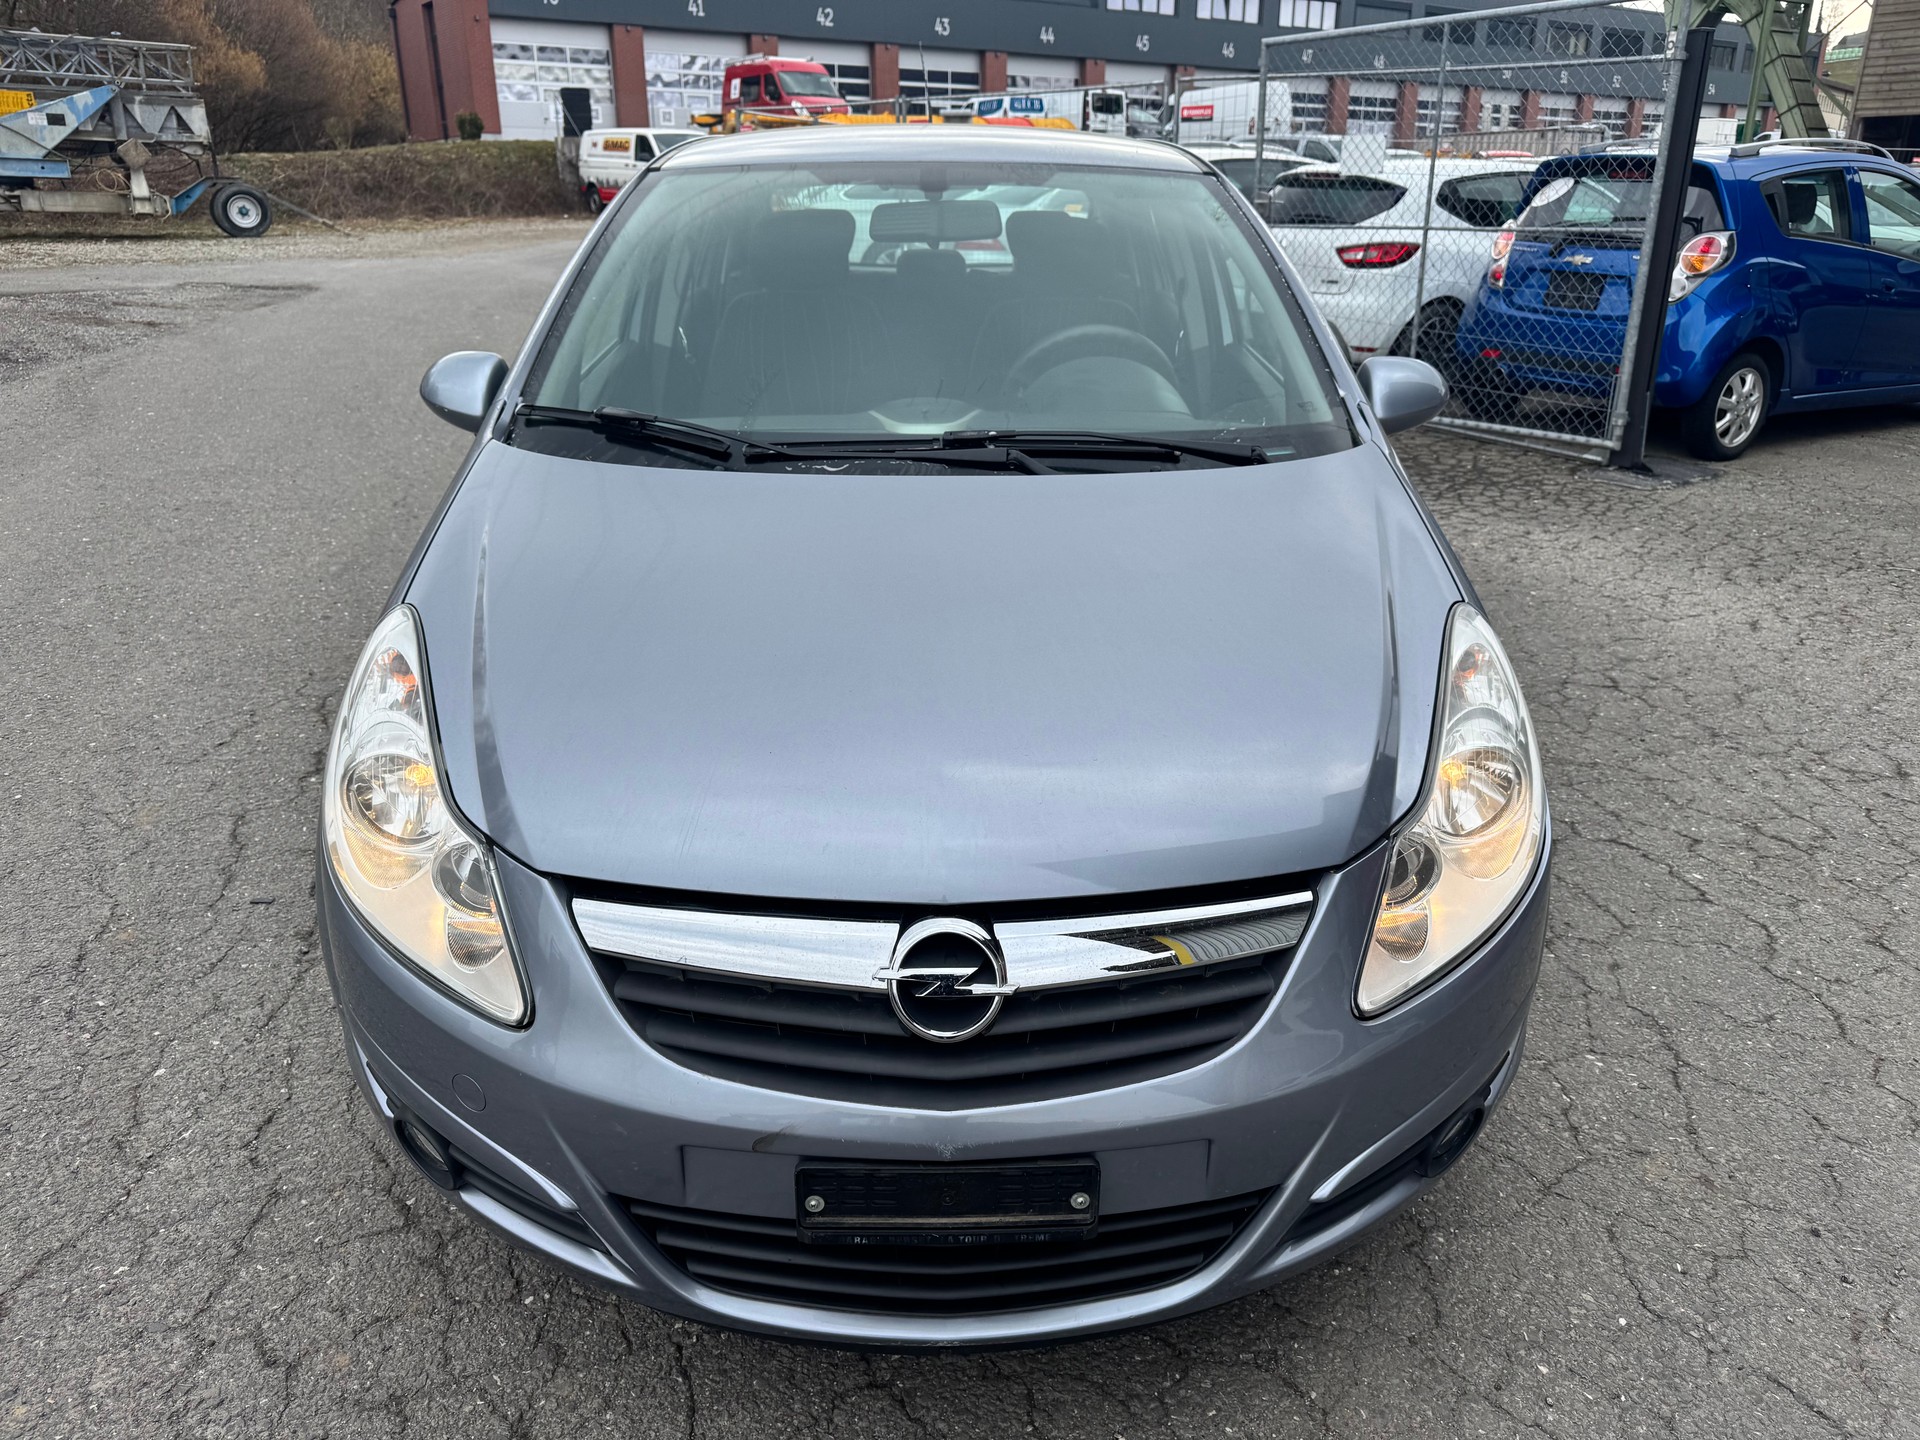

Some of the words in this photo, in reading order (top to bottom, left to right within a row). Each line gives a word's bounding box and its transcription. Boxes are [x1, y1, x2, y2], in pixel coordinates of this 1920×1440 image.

[688, 0, 706, 17] 41
[816, 7, 834, 27] 42
[934, 17, 951, 36] 43
[1040, 26, 1055, 44] 44
[1136, 34, 1150, 52] 45
[1222, 42, 1235, 59] 46
[1301, 48, 1313, 64] 47
[1373, 54, 1385, 69] 48
[1612, 75, 1622, 88] 52
[1707, 83, 1716, 96] 54
